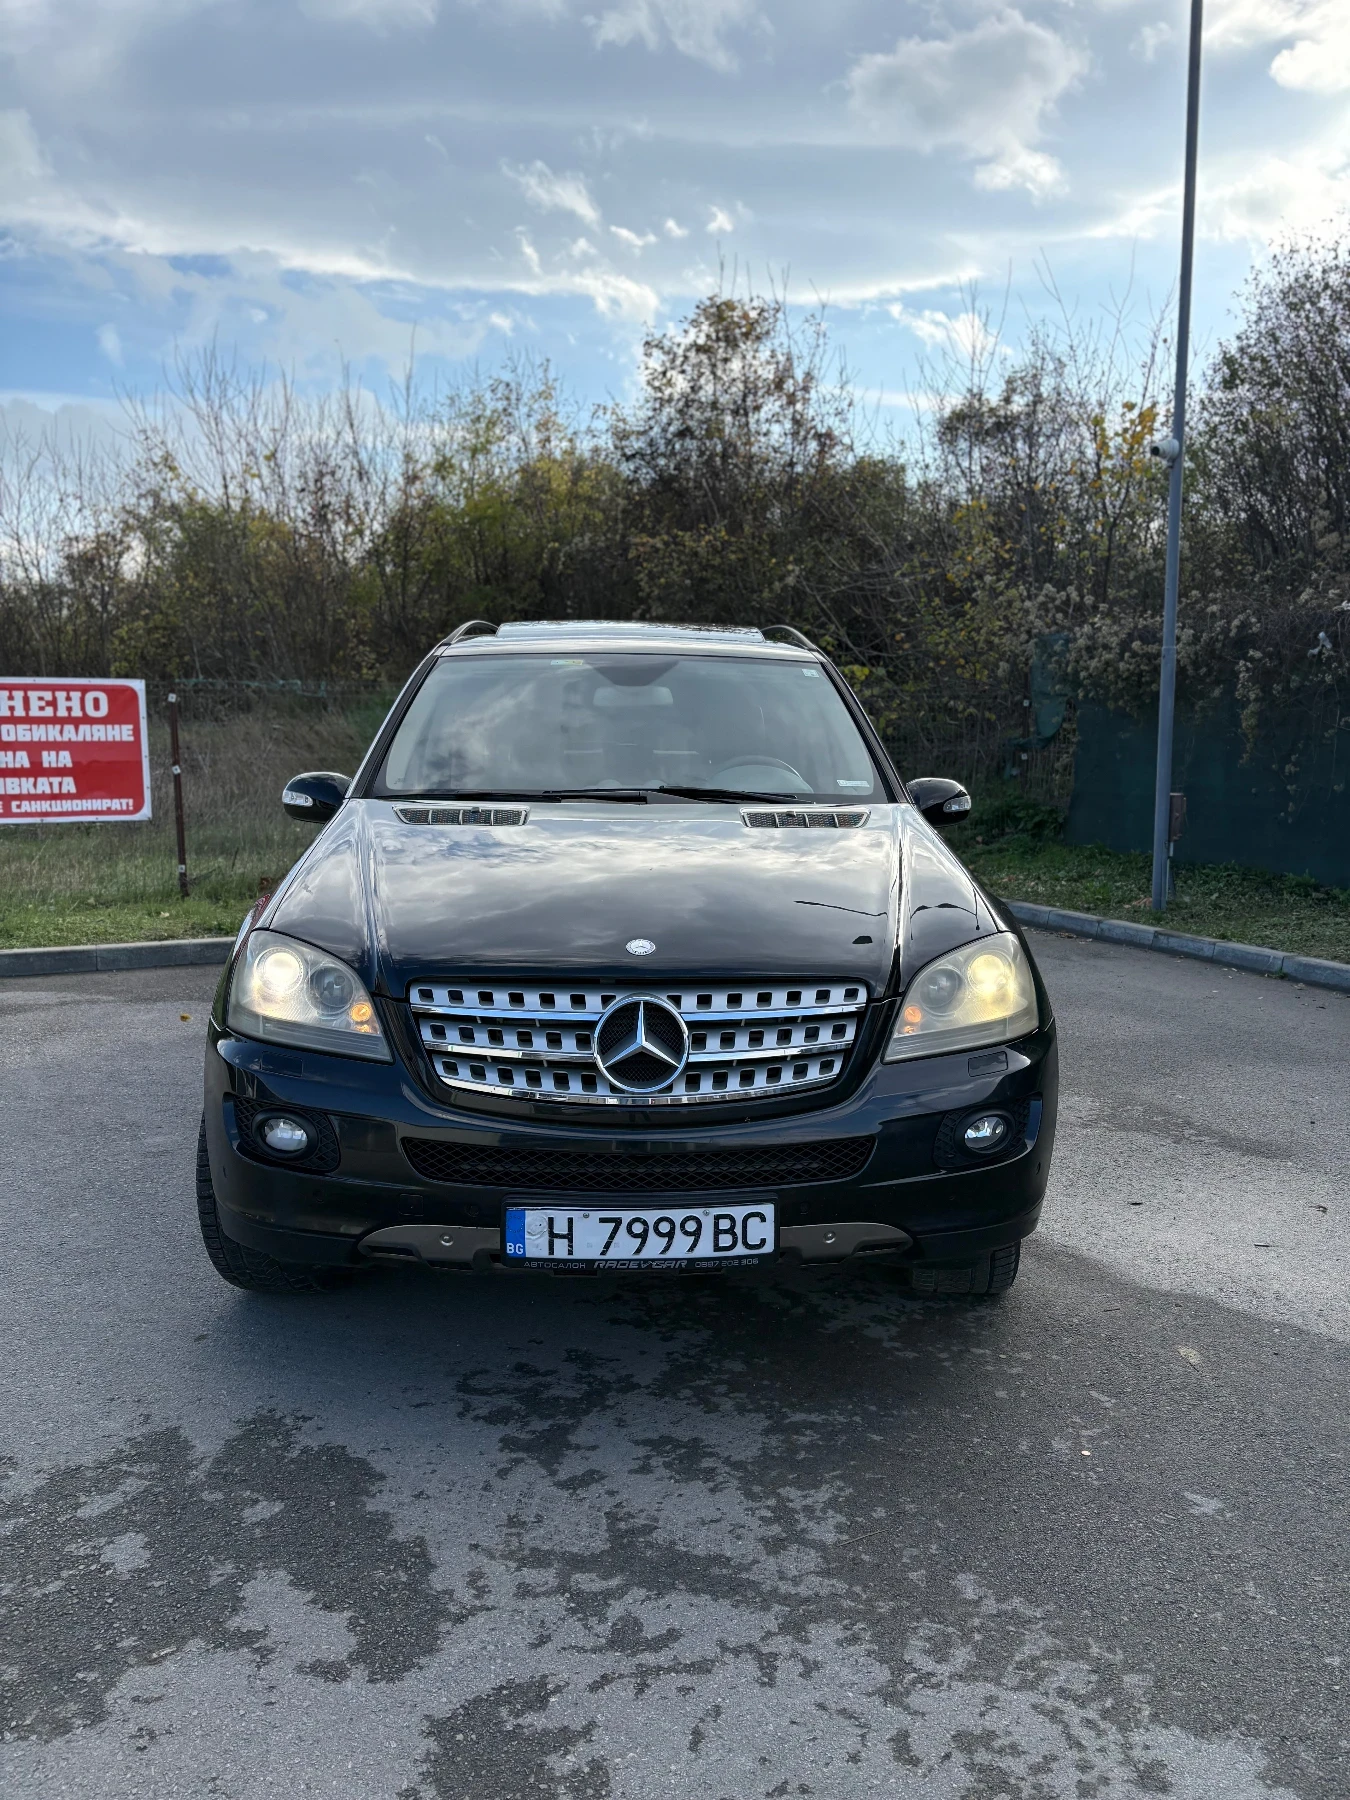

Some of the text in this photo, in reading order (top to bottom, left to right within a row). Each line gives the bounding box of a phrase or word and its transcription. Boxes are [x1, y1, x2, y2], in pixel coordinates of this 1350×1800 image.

[0, 690, 108, 718] НЕНО
[1, 724, 134, 742] ОБИКАЛЯНЕ
[0, 751, 73, 768] НА НА
[11, 799, 134, 813] САНКЦИОНИРАТ!
[547, 1211, 767, 1256] H 7999 BC
[506, 1243, 524, 1255] BG
[523, 1261, 586, 1269] АВТОСАЛОН
